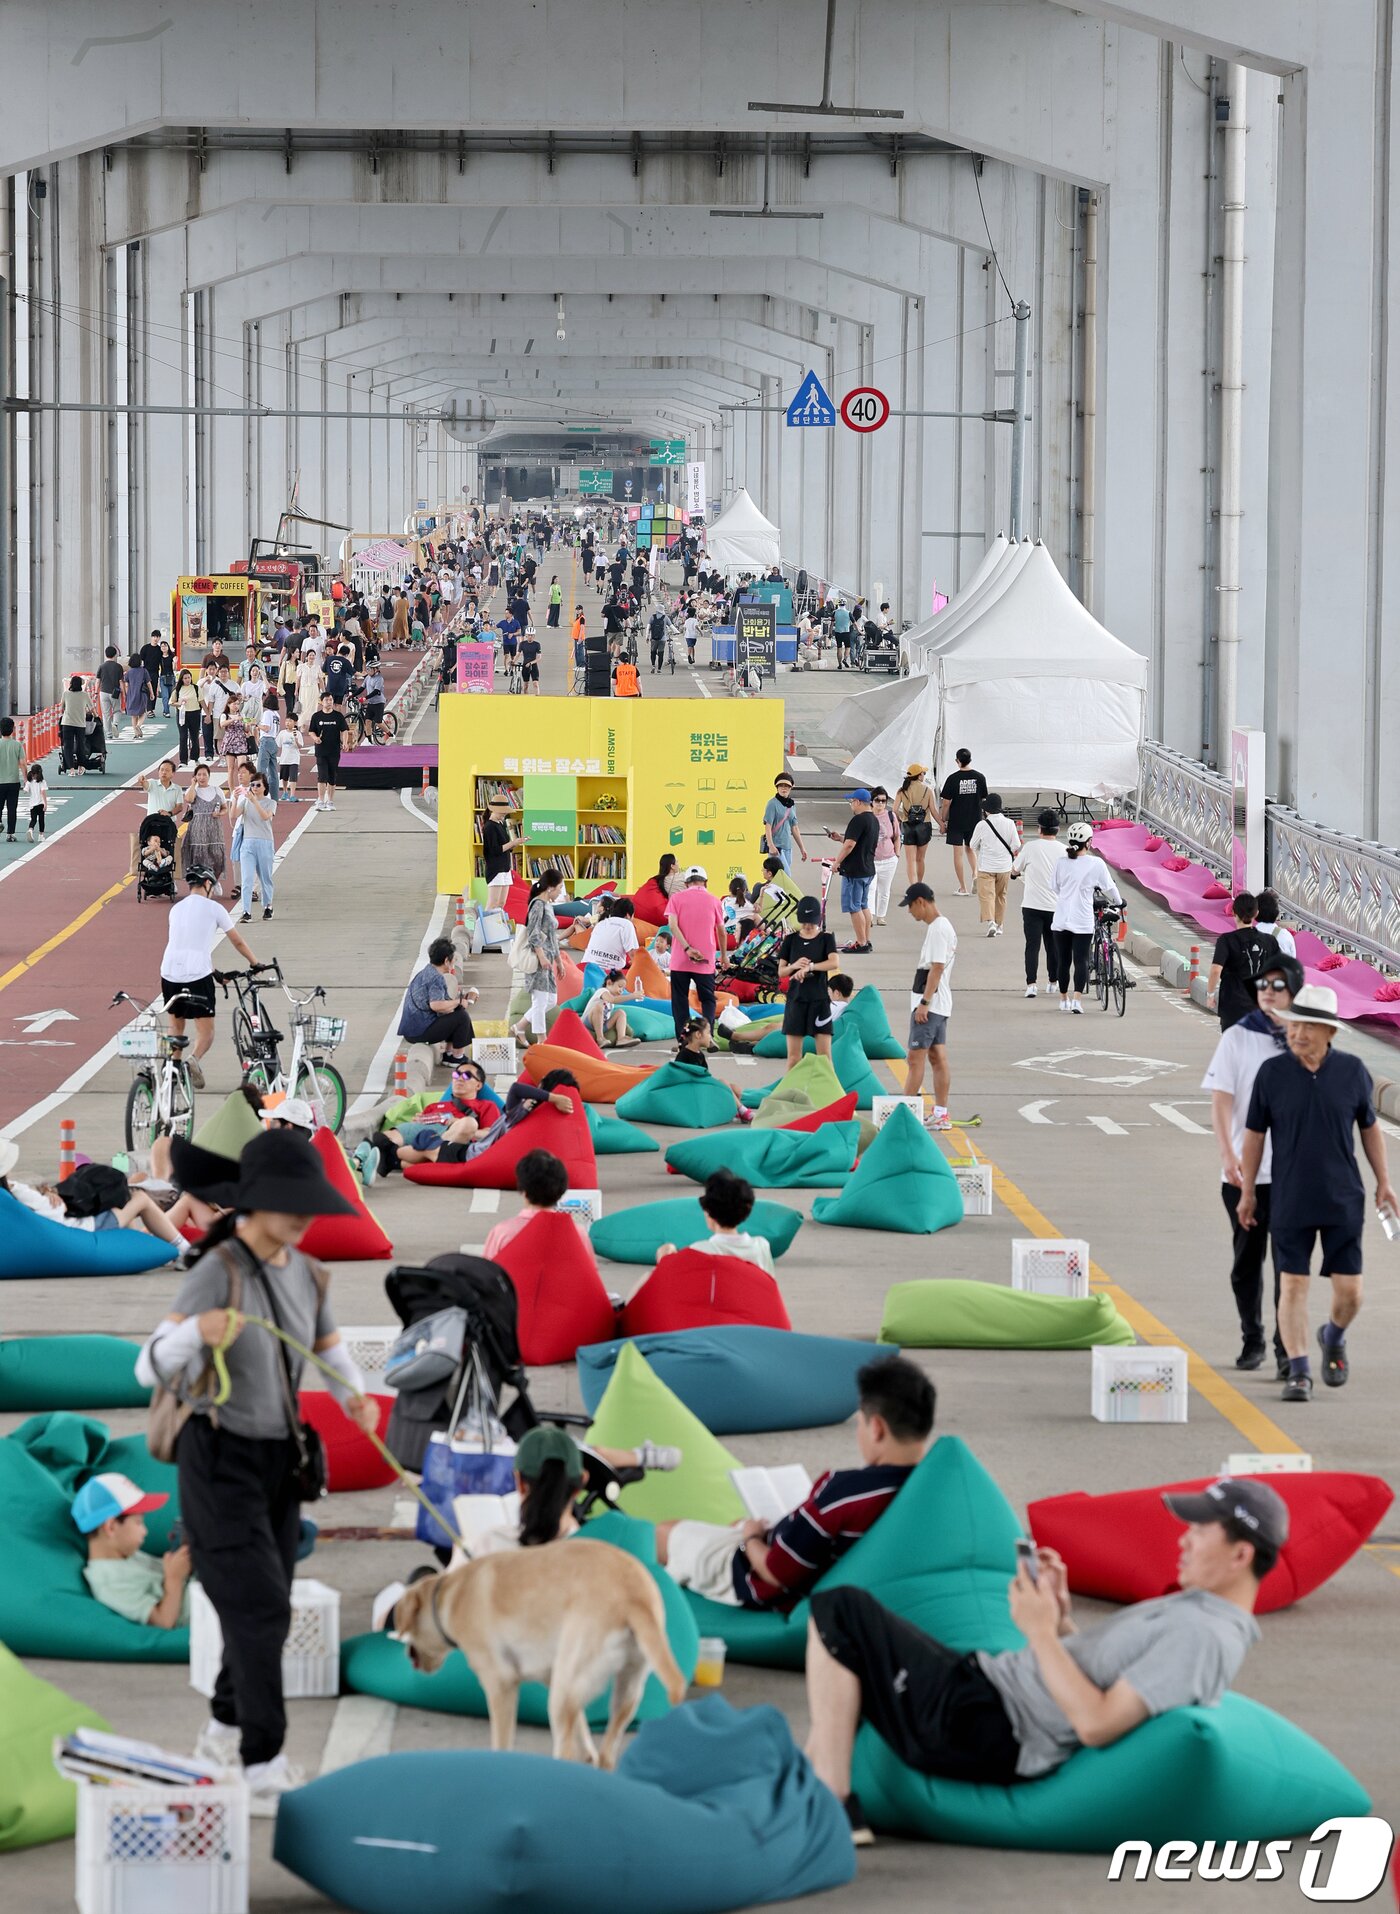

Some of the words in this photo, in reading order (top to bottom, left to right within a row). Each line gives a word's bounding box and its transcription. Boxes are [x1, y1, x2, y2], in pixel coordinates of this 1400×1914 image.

[851, 398, 877, 421] 40
[792, 416, 831, 425] 횡단보도
[182, 581, 211, 590] EXTREME
[220, 581, 245, 590] COFFEE
[742, 618, 771, 626] 다회용기
[742, 625, 770, 637] 반납!
[465, 661, 489, 670] 잠수교
[465, 670, 489, 678] 라이브
[607, 728, 615, 758] JAMSU
[690, 733, 728, 747] 책읽는
[690, 749, 728, 763] 잠수교
[503, 758, 519, 773] 책
[521, 758, 552, 773] 읽는
[555, 758, 601, 774] 잠수교
[607, 759, 615, 775] BRI
